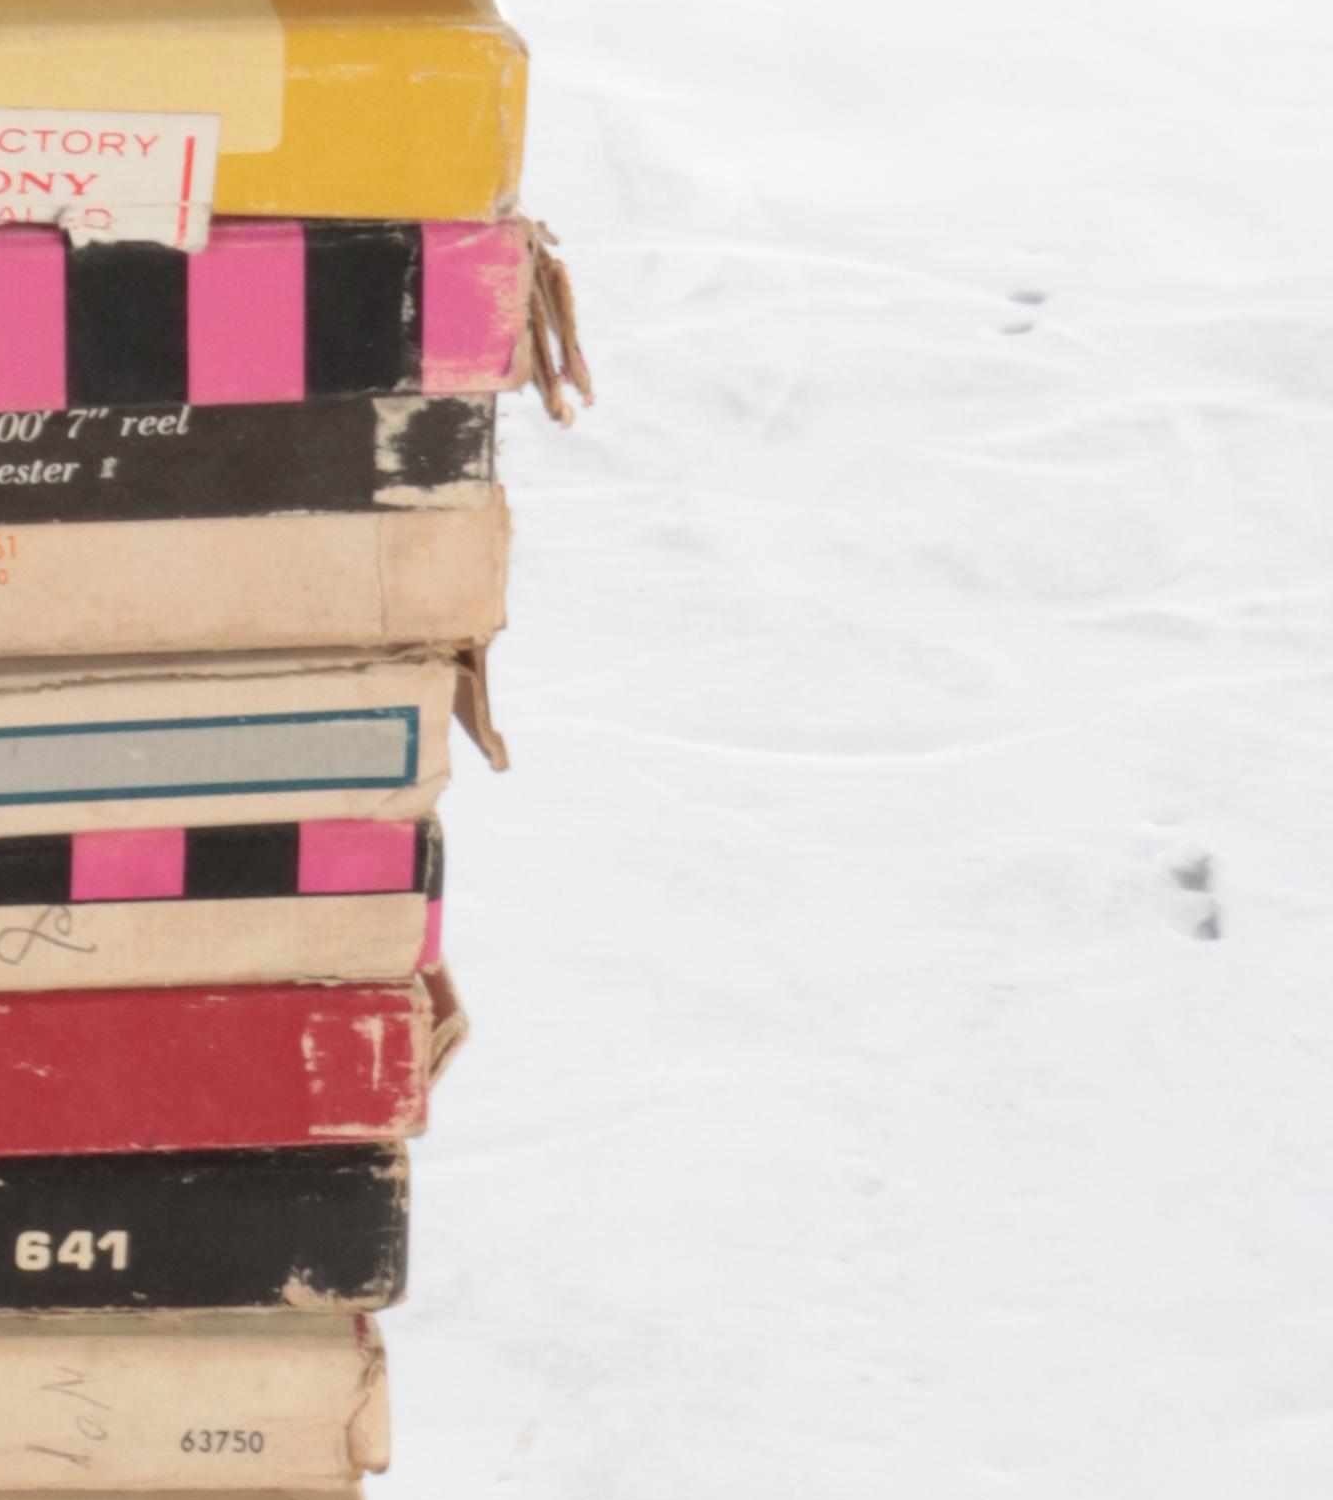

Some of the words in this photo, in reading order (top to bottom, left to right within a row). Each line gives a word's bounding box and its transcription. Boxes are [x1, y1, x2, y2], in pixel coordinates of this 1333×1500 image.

[119, 405, 191, 438] reel
[14, 1230, 130, 1271] 641
[178, 1429, 265, 1455] 63750
